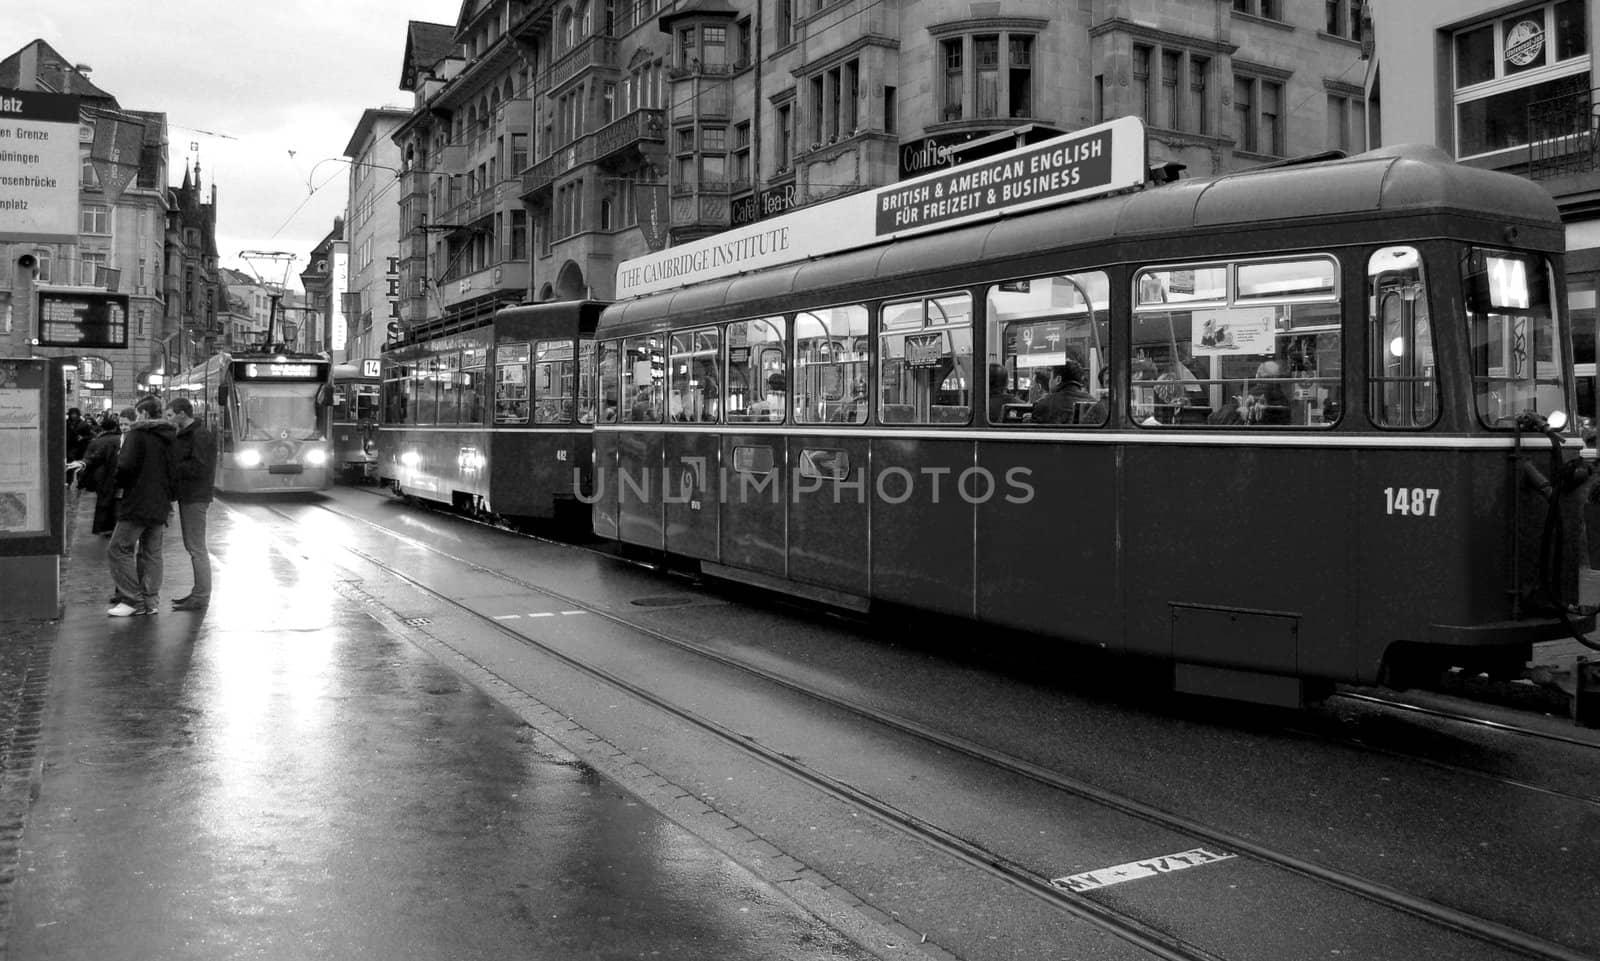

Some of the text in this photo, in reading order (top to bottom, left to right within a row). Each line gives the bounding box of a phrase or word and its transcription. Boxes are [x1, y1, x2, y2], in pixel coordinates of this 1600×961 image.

[16, 128, 49, 140] Grenze
[882, 139, 1103, 212] BRITISH & AMERICAN ENGLISH
[895, 167, 1081, 226] FÜR FREIZEIT & BUSINESS
[621, 227, 790, 289] THE CAMBRIDGE INSTITUTE
[249, 363, 258, 378] 6
[365, 361, 379, 376] 14
[1384, 487, 1440, 517] 1487
